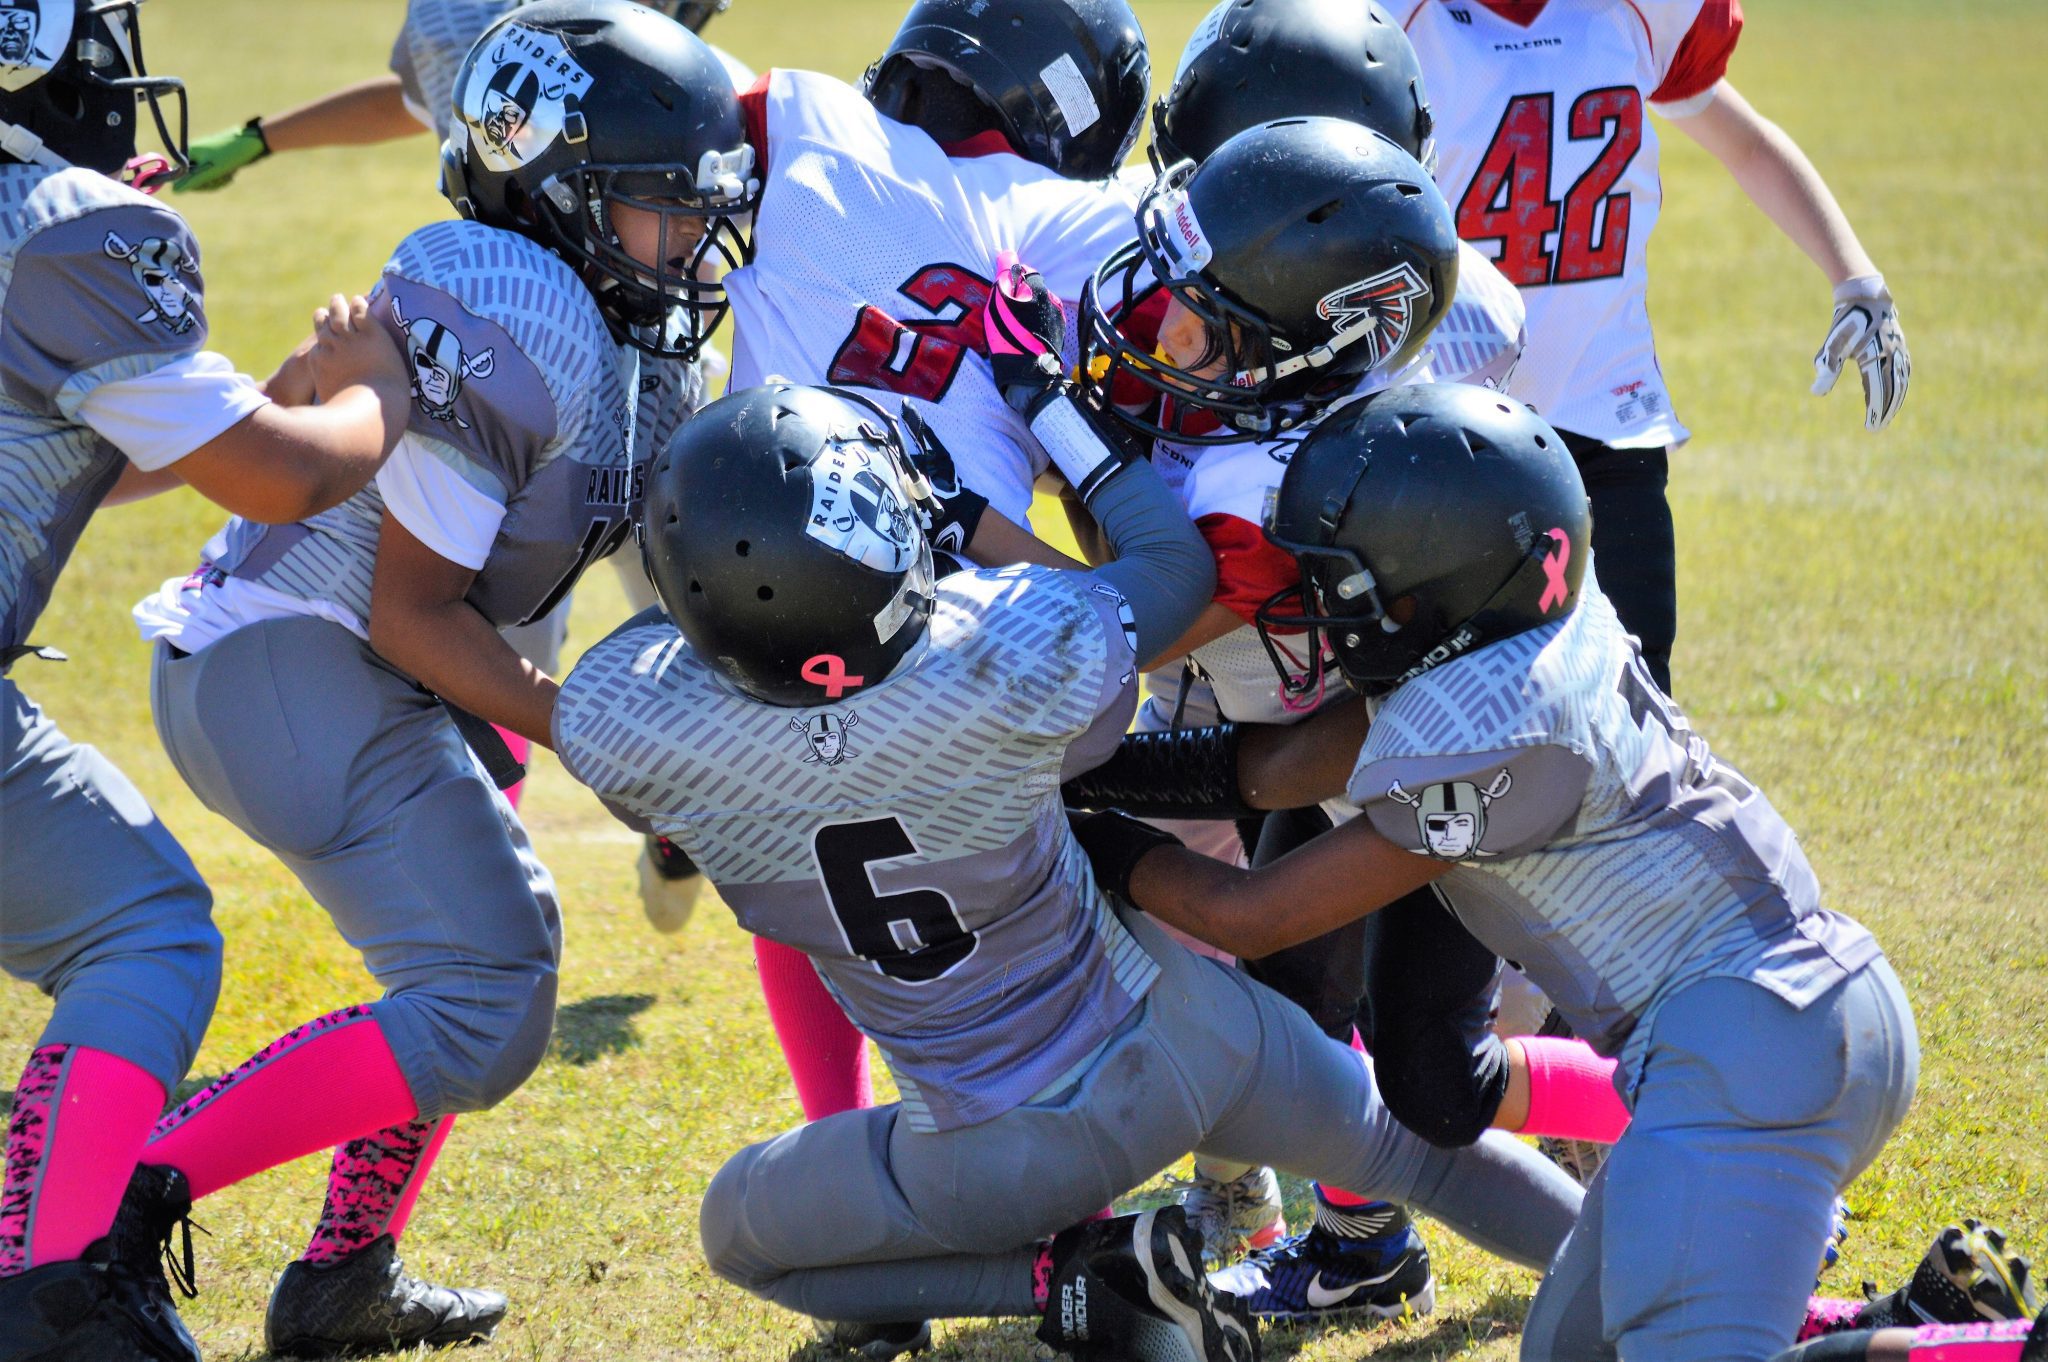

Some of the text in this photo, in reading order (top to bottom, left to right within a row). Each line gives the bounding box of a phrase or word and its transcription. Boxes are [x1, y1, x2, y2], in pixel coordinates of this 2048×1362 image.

[504, 28, 585, 84] RAIDERS
[1494, 38, 1562, 51] FALCONS
[1454, 85, 1643, 288] 42
[1175, 202, 1200, 248] Riddell
[812, 444, 848, 528] RAIDER
[810, 814, 981, 987] 6
